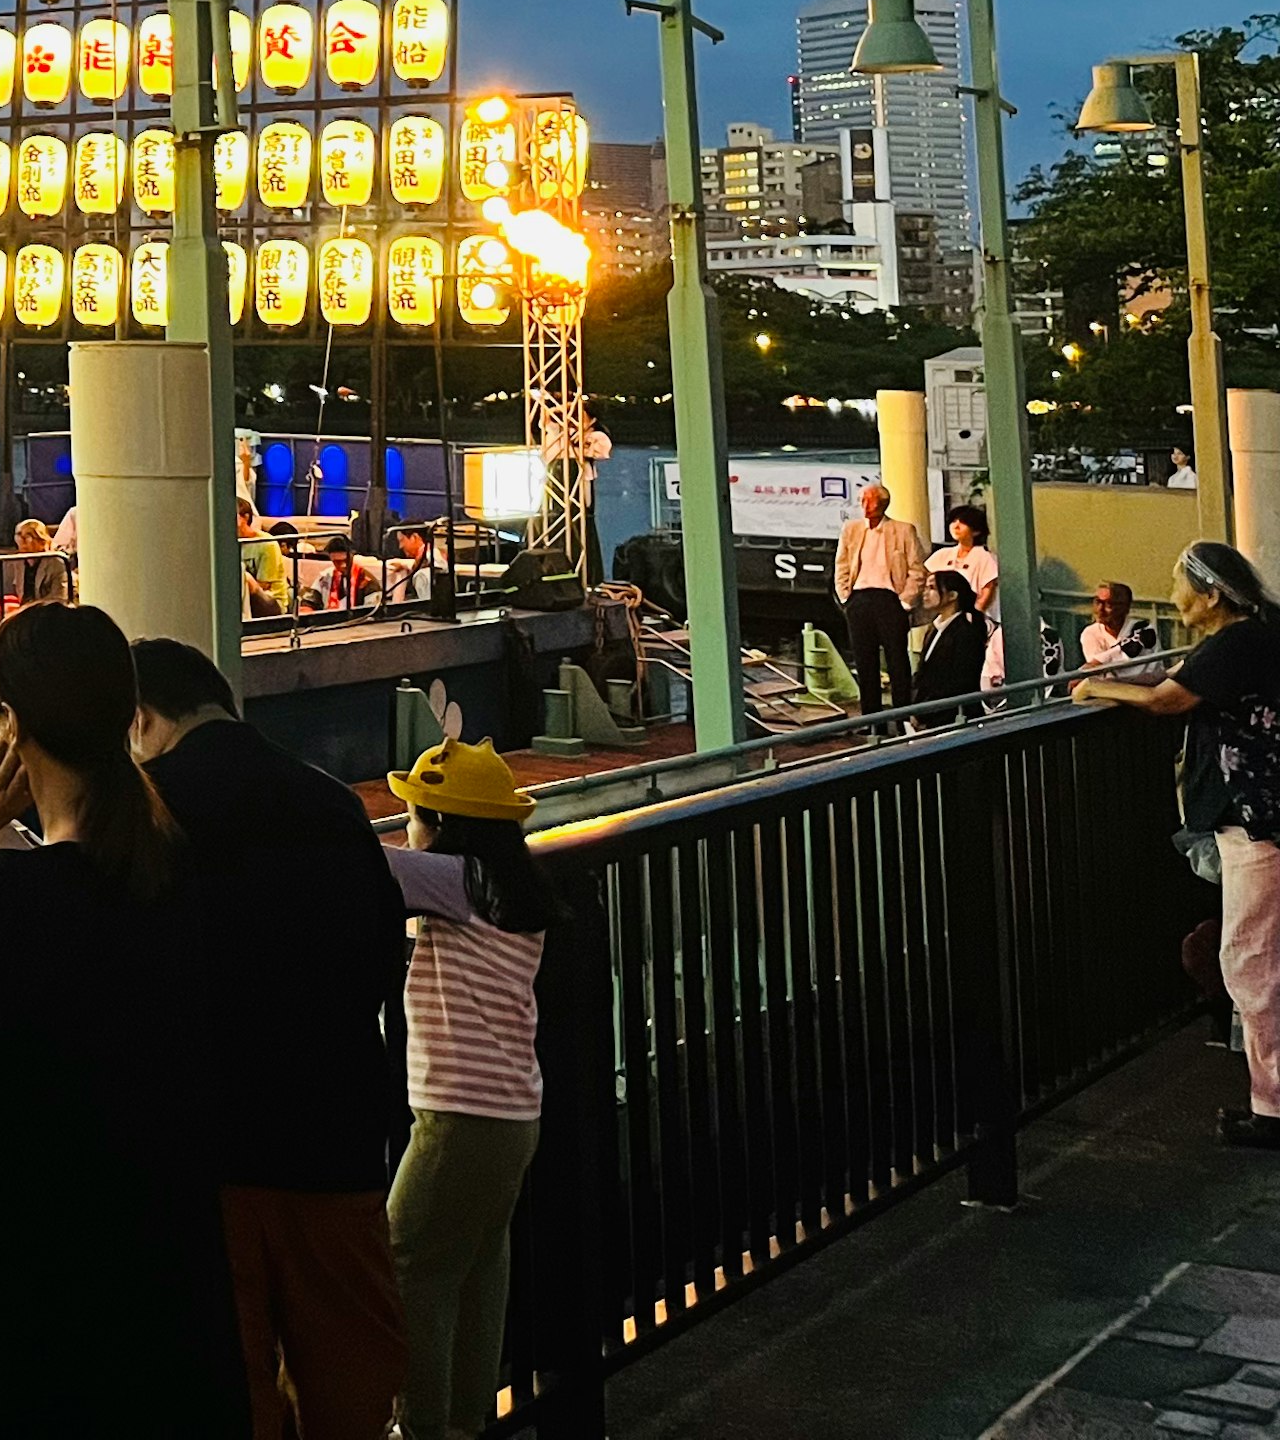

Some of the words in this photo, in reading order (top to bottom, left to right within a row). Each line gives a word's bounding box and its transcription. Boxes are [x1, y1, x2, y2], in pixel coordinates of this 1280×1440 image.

[395, 5, 429, 65] 能船
[79, 140, 99, 200] 喜多流
[137, 138, 160, 197] 宝生流
[262, 132, 288, 192] 高安流
[394, 126, 419, 188] 森田流
[259, 249, 283, 310] 観世流
[391, 247, 418, 310] 観世流
